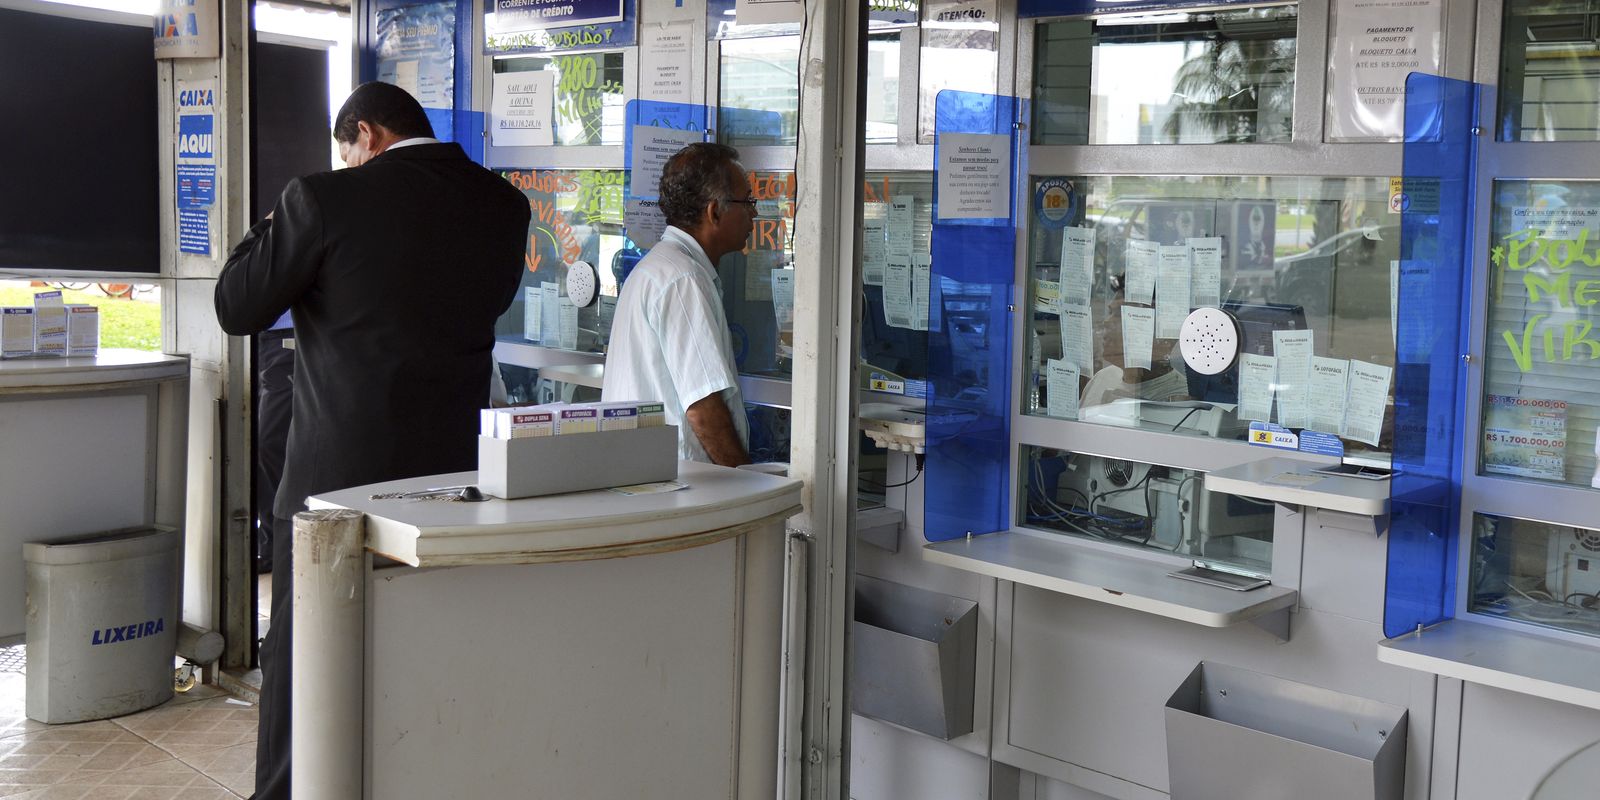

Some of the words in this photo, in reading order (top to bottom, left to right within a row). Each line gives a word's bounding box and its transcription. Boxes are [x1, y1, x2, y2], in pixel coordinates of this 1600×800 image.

[542, 4, 574, 17] CRÉDITO
[936, 8, 985, 21] ATENÇÃO:
[180, 89, 213, 106] CAIXA
[180, 134, 212, 153] AQUI
[1041, 179, 1072, 193] APOSTAR
[1486, 433, 1498, 442] R$
[1501, 435, 1564, 448] 1.700.000,00
[92, 618, 163, 645] LIXEIRA
